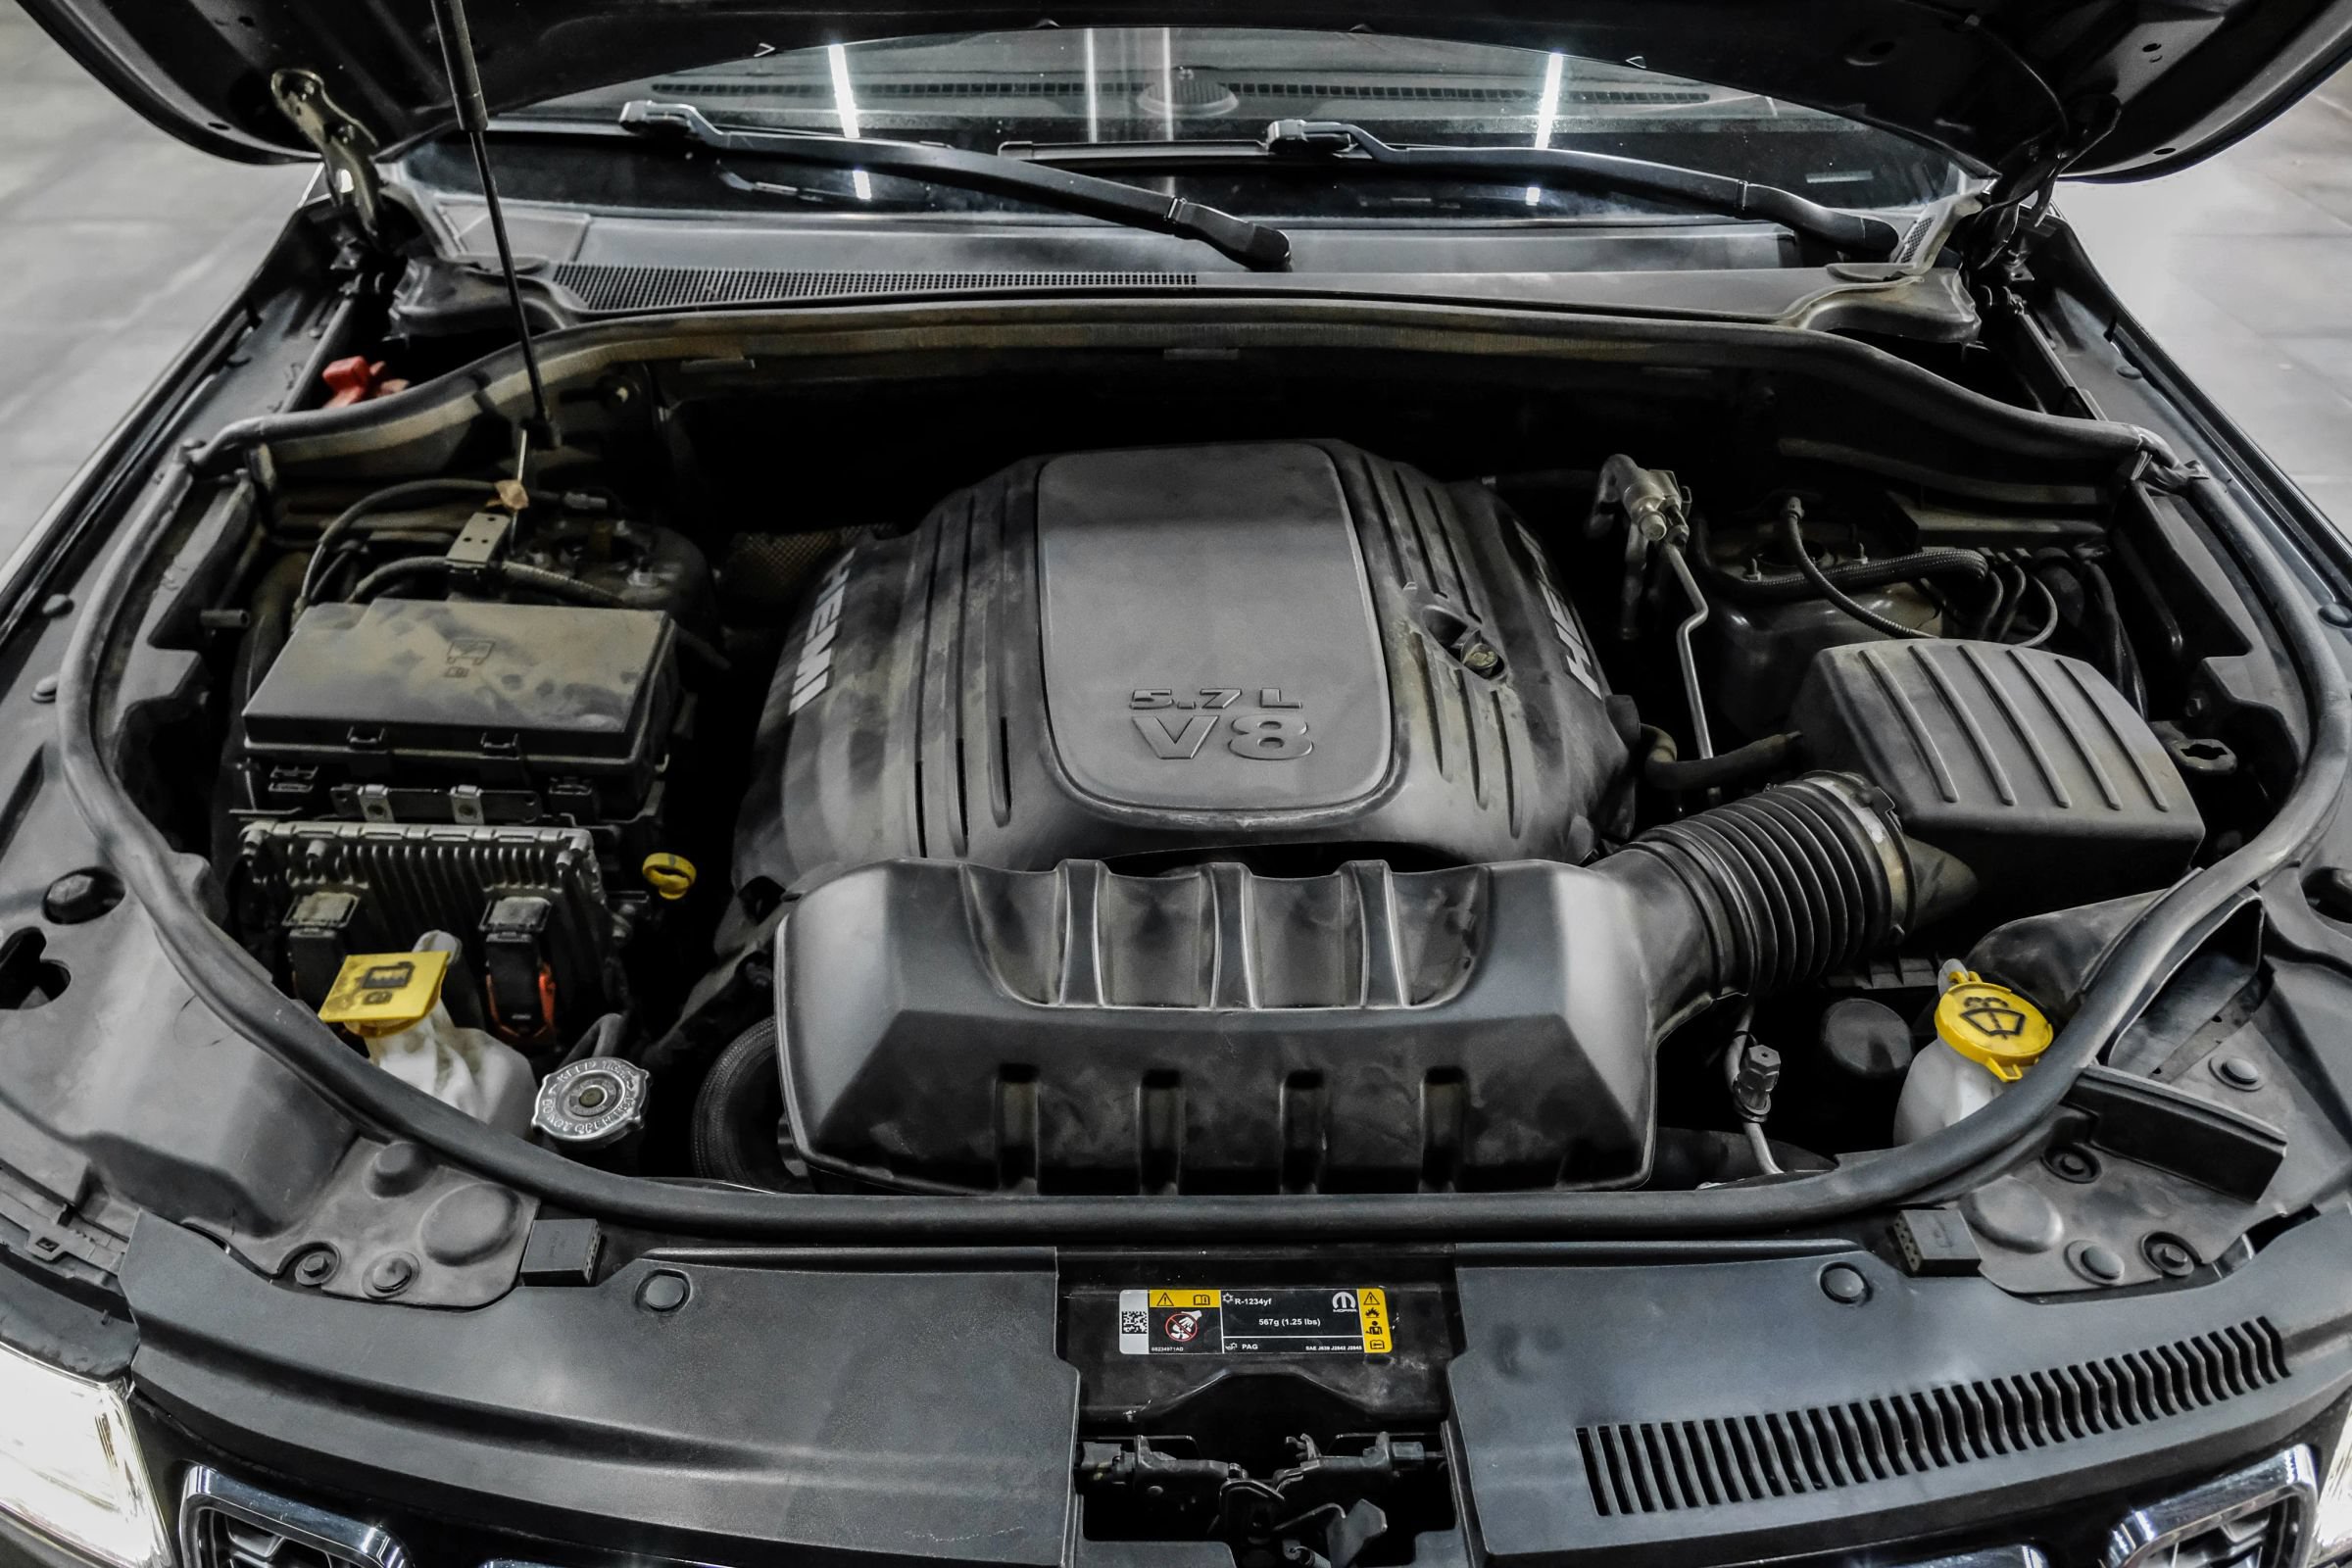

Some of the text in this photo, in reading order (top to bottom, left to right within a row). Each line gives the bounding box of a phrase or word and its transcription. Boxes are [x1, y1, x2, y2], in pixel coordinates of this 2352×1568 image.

[787, 547, 857, 716] HEMI
[1129, 688, 1303, 710] 5.7 L
[1131, 713, 1314, 761] V8
[557, 1061, 597, 1083] KEEP
[1234, 1298, 1272, 1306] R-1234yf
[1258, 1318, 1321, 1327] 567g (1.25 lbs)
